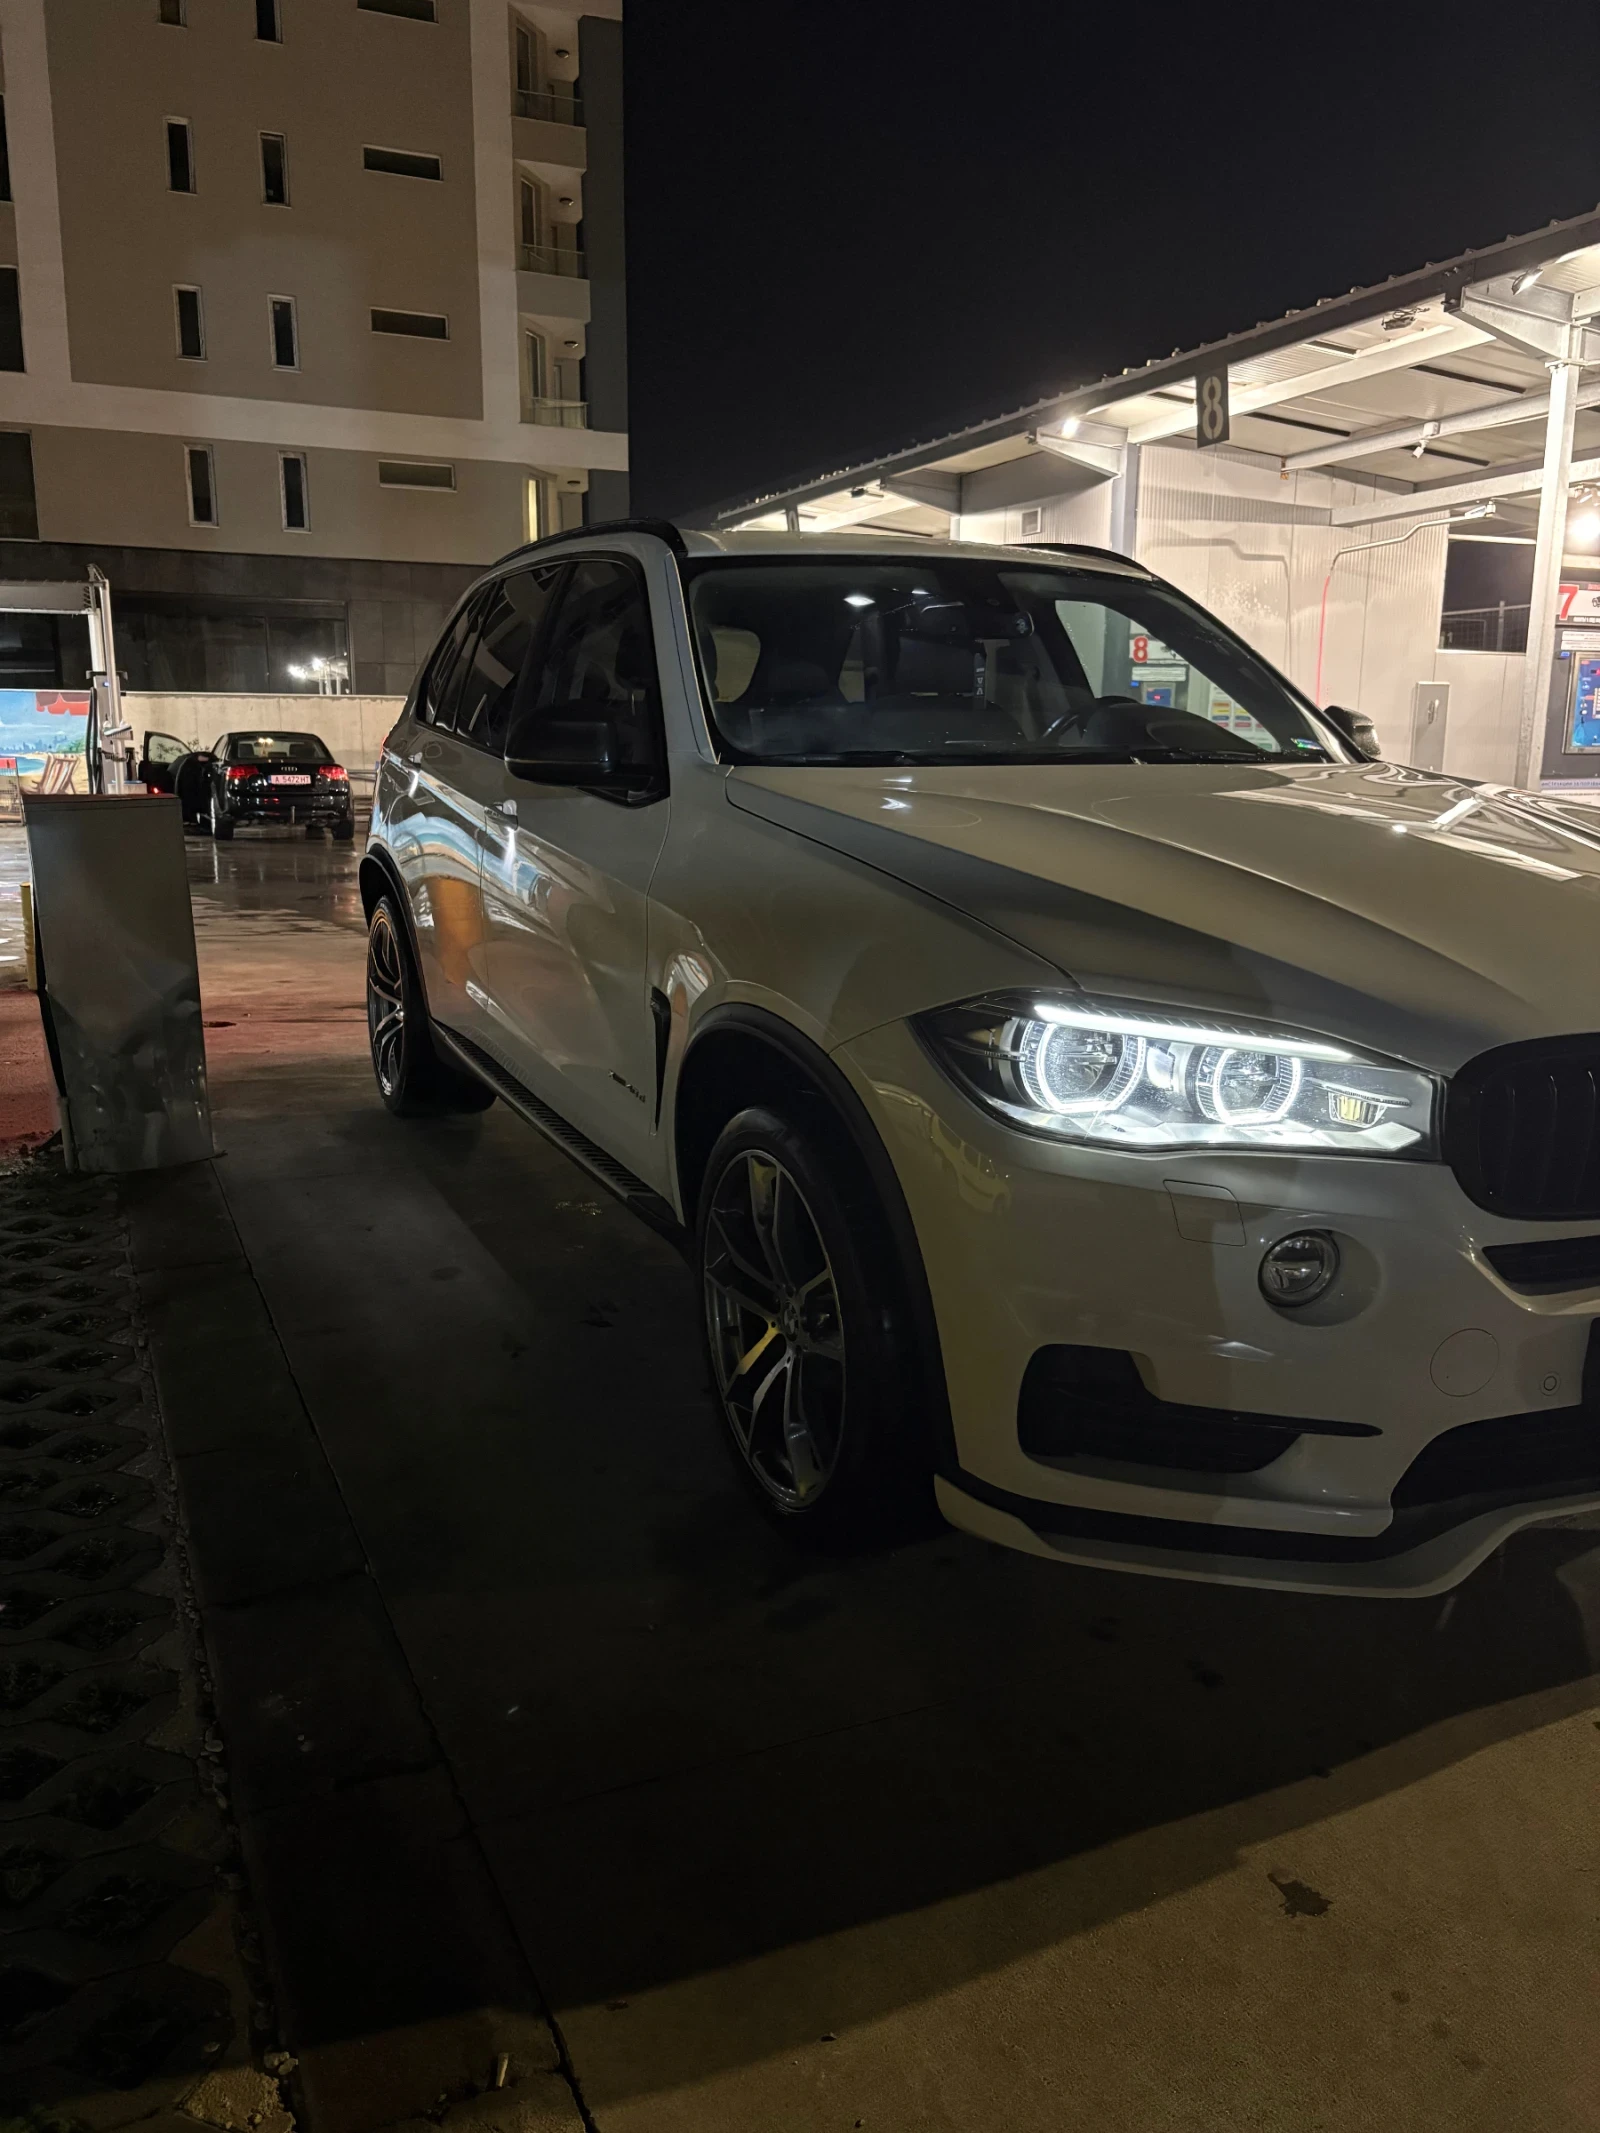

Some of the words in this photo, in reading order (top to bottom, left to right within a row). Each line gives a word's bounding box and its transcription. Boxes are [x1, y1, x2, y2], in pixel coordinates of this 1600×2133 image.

[1203, 376, 1223, 440] 8
[1559, 584, 1579, 620] 7
[1133, 636, 1148, 663] 8
